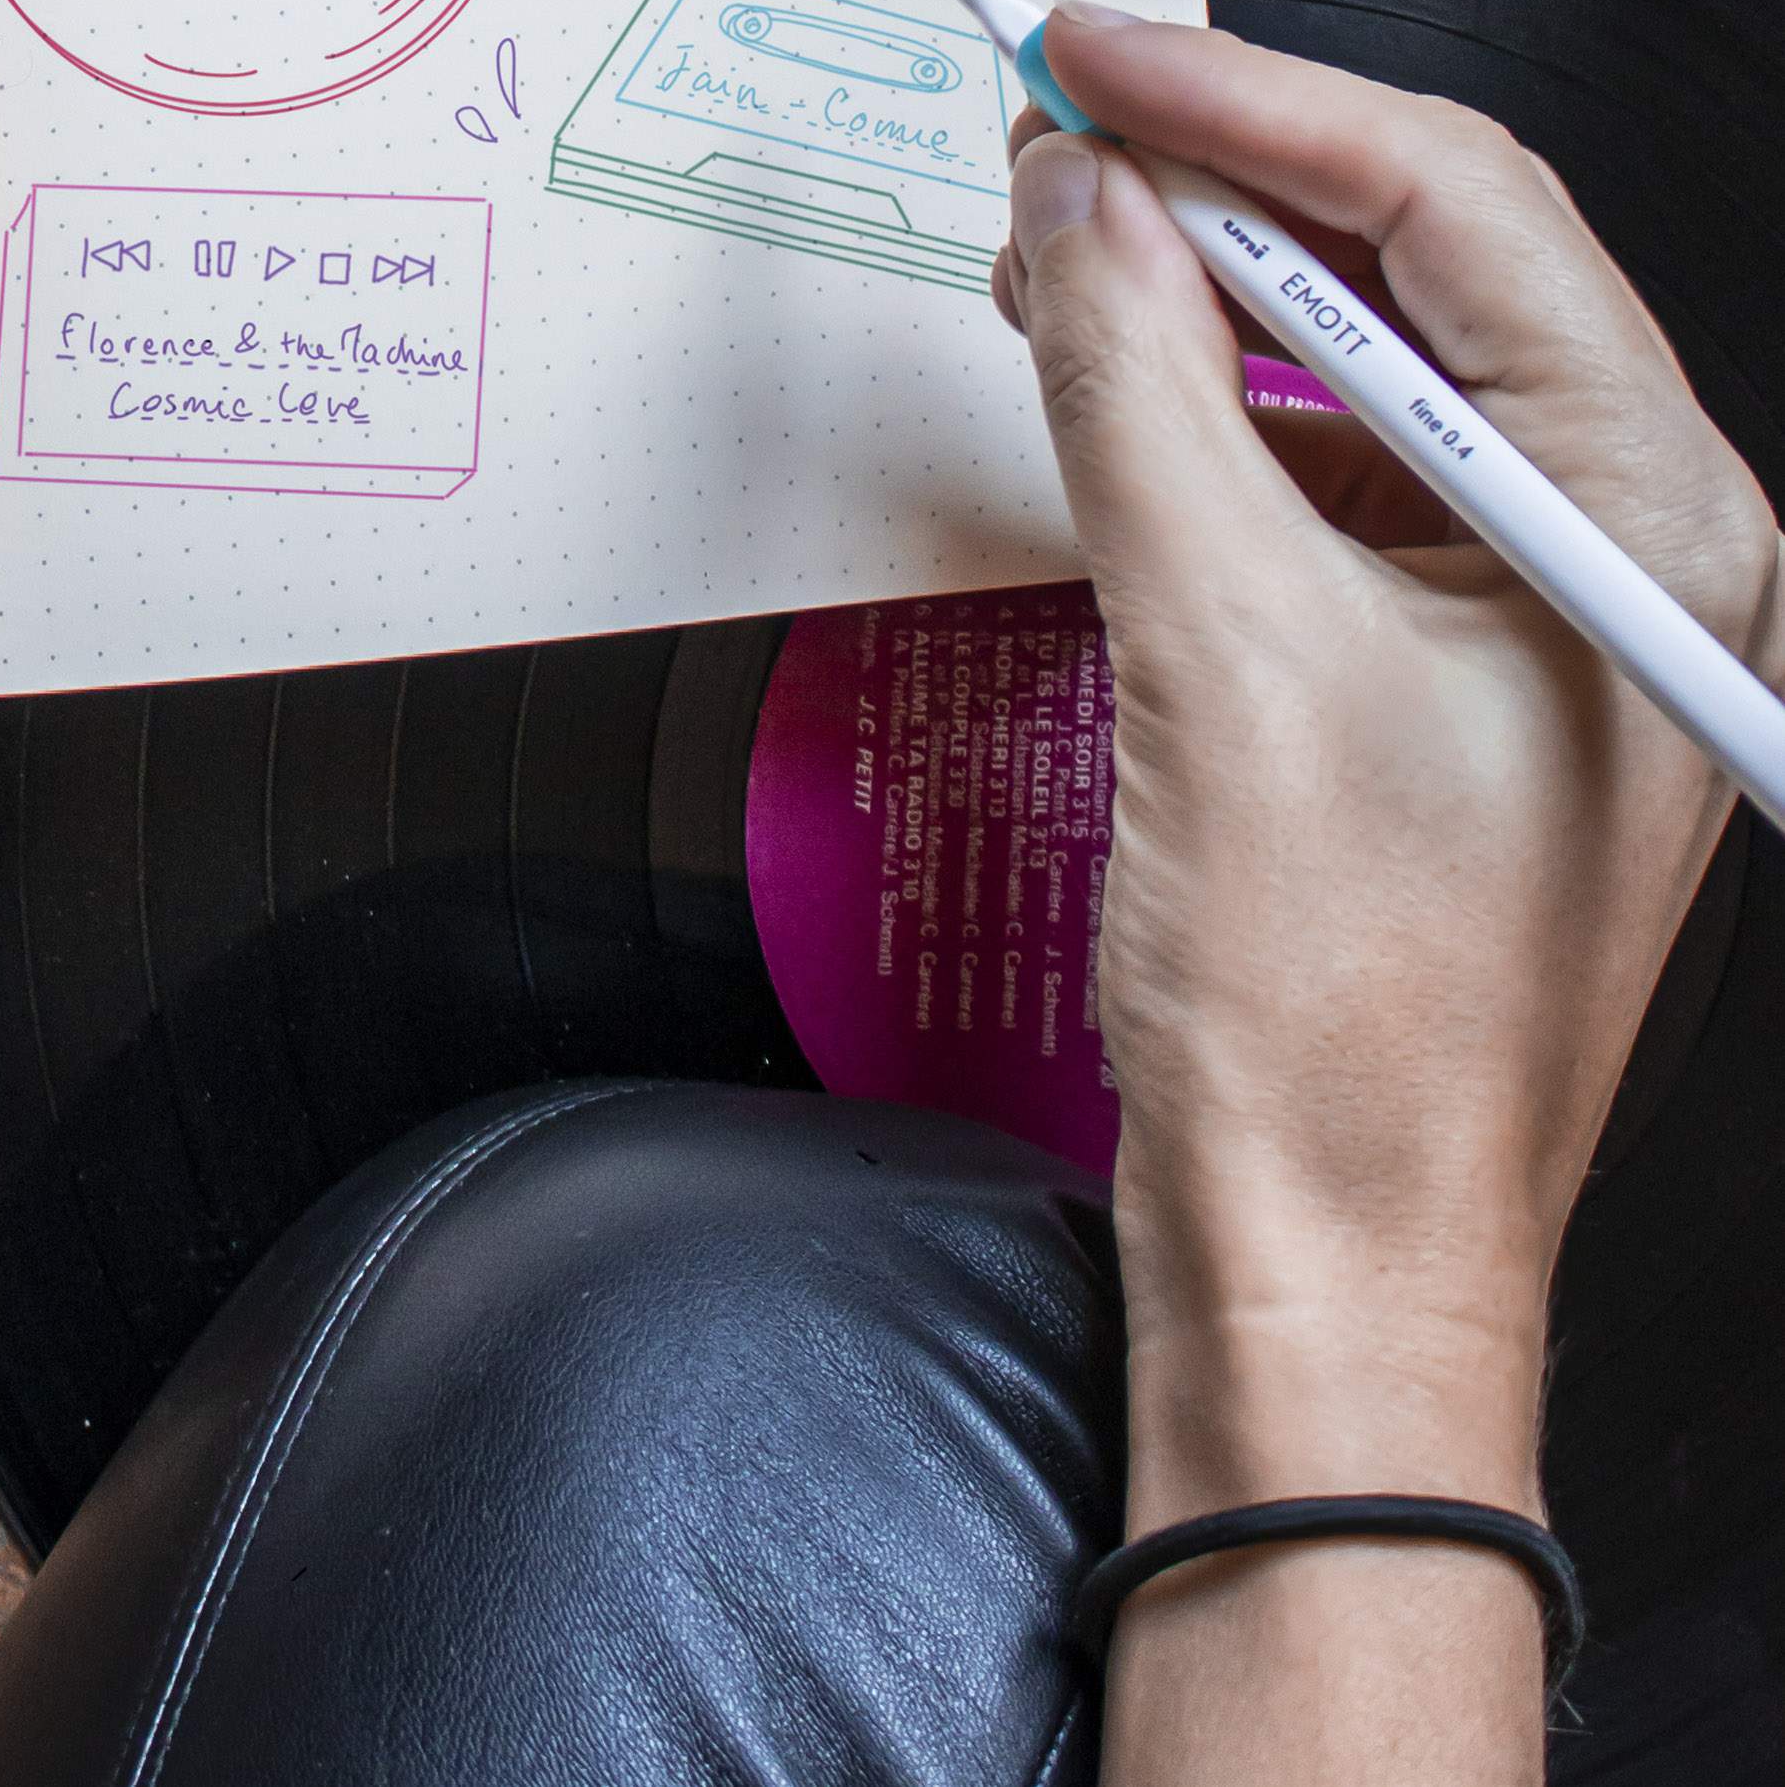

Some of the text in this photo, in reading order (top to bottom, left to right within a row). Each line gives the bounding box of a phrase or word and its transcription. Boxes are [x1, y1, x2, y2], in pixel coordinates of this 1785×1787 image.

[234, 322, 260, 353] &
[280, 331, 335, 361] the
[340, 323, 469, 372] Machine
[1222, 219, 1475, 461] uni EMOTT fine 0.4
[110, 381, 254, 418] Cosmic
[952, 630, 972, 657] LE
[992, 633, 1015, 689] NON
[1036, 630, 1057, 661] TU
[906, 629, 934, 727] ALLUME
[1035, 669, 1055, 698] ES
[1073, 630, 1101, 725] SAMEDI
[948, 664, 973, 758] COUPLE
[1033, 705, 1054, 732] LE
[851, 746, 875, 814] PETIT
[907, 736, 928, 768] TA
[1028, 739, 1053, 819] SOLEIL
[1071, 732, 1095, 790] SOIR
[902, 774, 926, 851] RADIO
